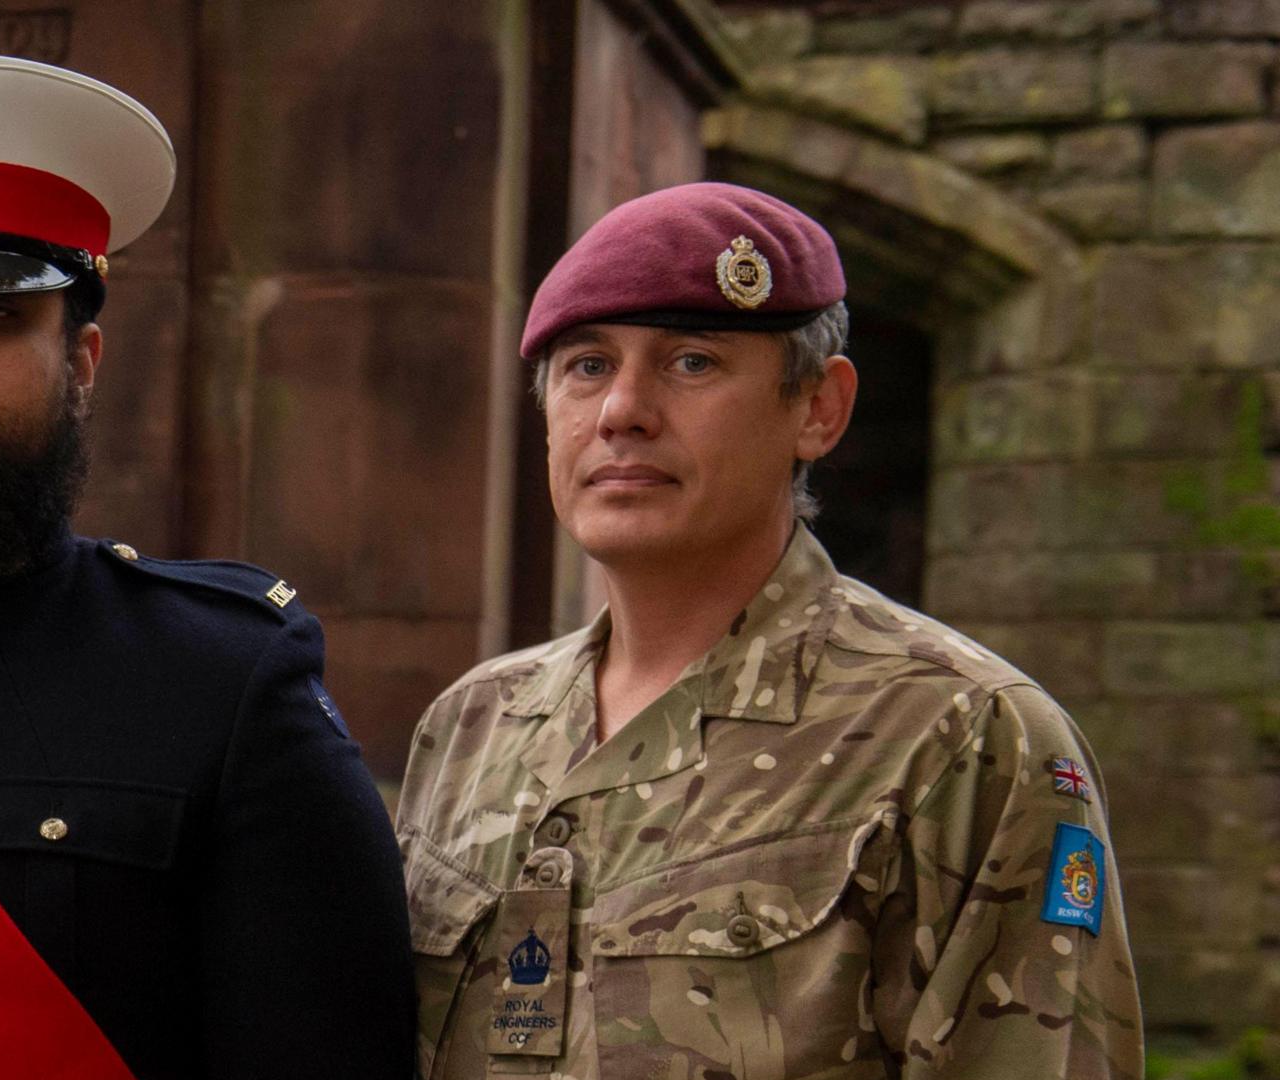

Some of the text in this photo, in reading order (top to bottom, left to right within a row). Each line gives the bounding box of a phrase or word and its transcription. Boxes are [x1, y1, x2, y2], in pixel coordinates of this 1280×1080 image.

[505, 999, 545, 1012] ROYAL
[494, 1015, 556, 1030] ENGINEERS
[508, 1031, 534, 1045] CCF
